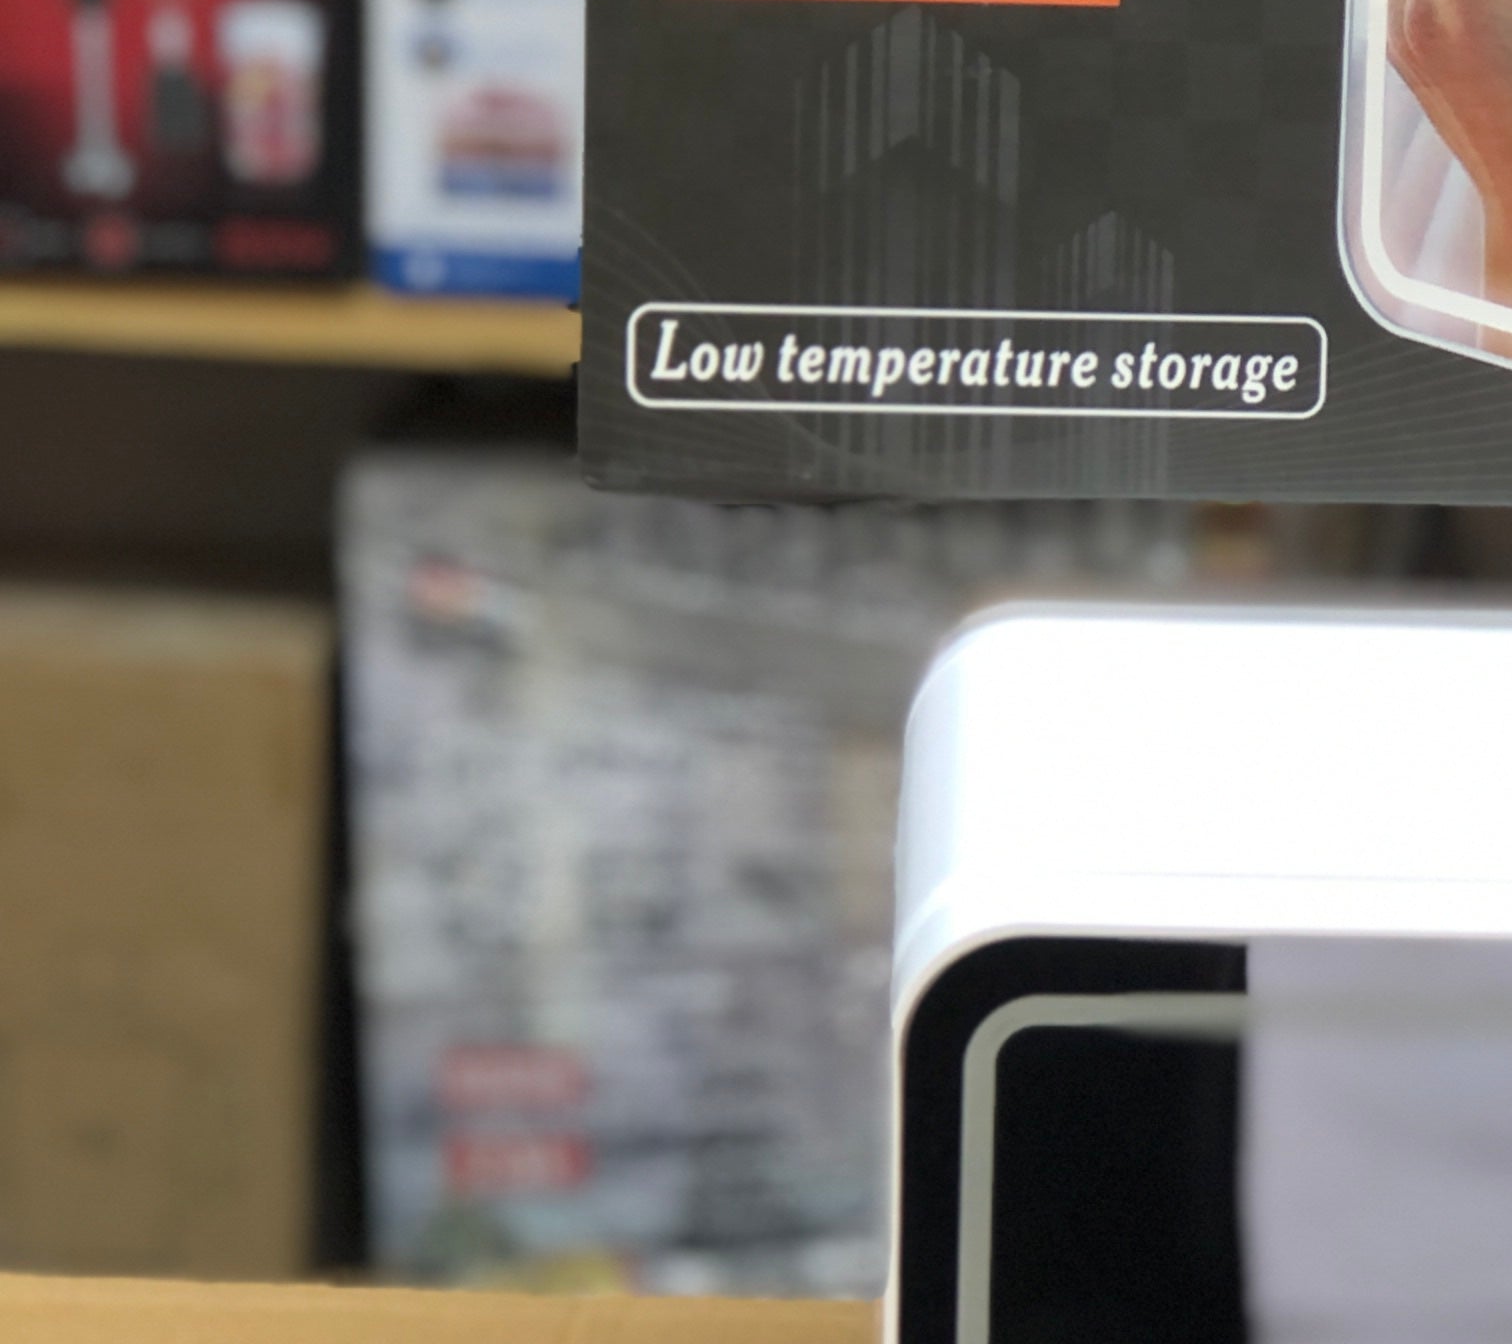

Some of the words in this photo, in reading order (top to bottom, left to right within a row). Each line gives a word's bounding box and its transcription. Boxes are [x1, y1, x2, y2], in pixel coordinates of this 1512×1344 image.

[650, 318, 764, 383] Low
[777, 334, 1099, 398] temperature
[1110, 341, 1299, 404] storage
